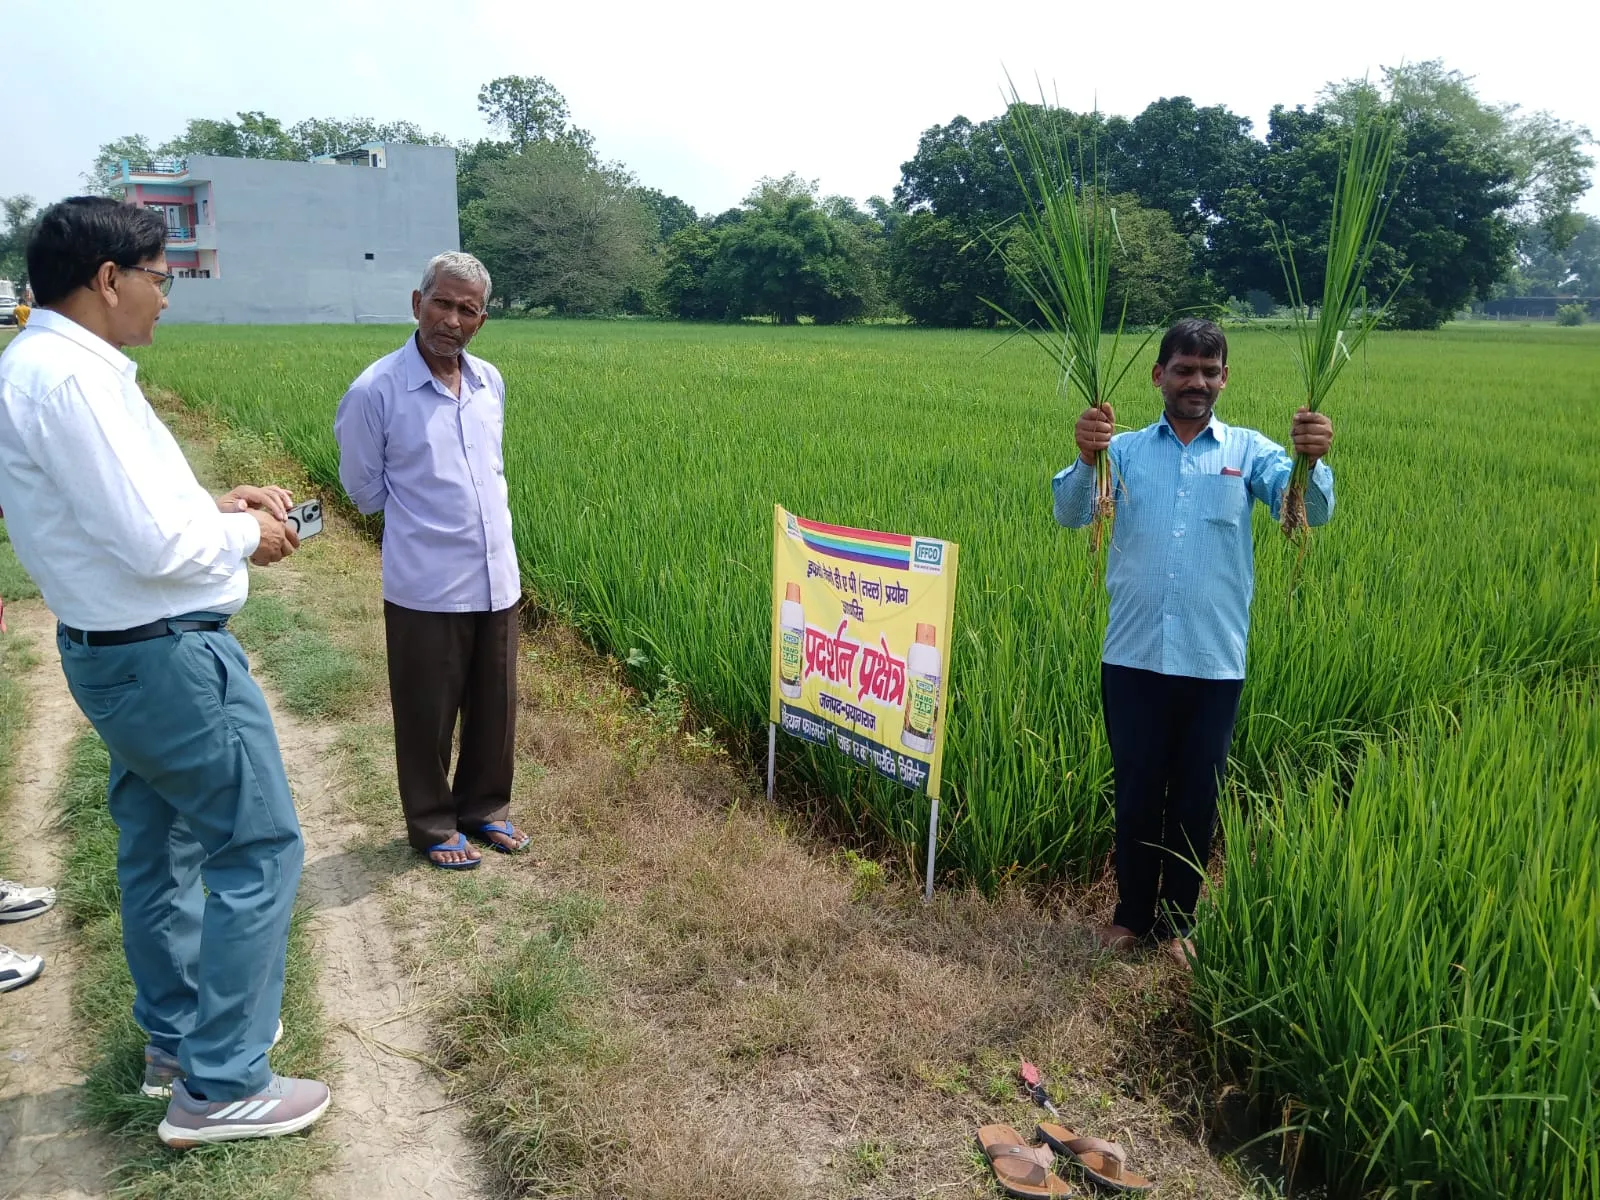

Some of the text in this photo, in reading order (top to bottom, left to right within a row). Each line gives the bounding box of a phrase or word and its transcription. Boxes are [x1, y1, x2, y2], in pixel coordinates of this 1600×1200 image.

[918, 546, 938, 560] IFFCO
[834, 567, 842, 590] डी
[842, 575, 848, 592] ए
[848, 571, 857, 594] पी
[859, 573, 883, 606] (तरल)
[885, 580, 909, 605] प्रयोग
[804, 620, 905, 705] प्रदर्शन प्रक्षेत्र
[915, 693, 933, 703] NANO
[914, 700, 932, 715] DAP
